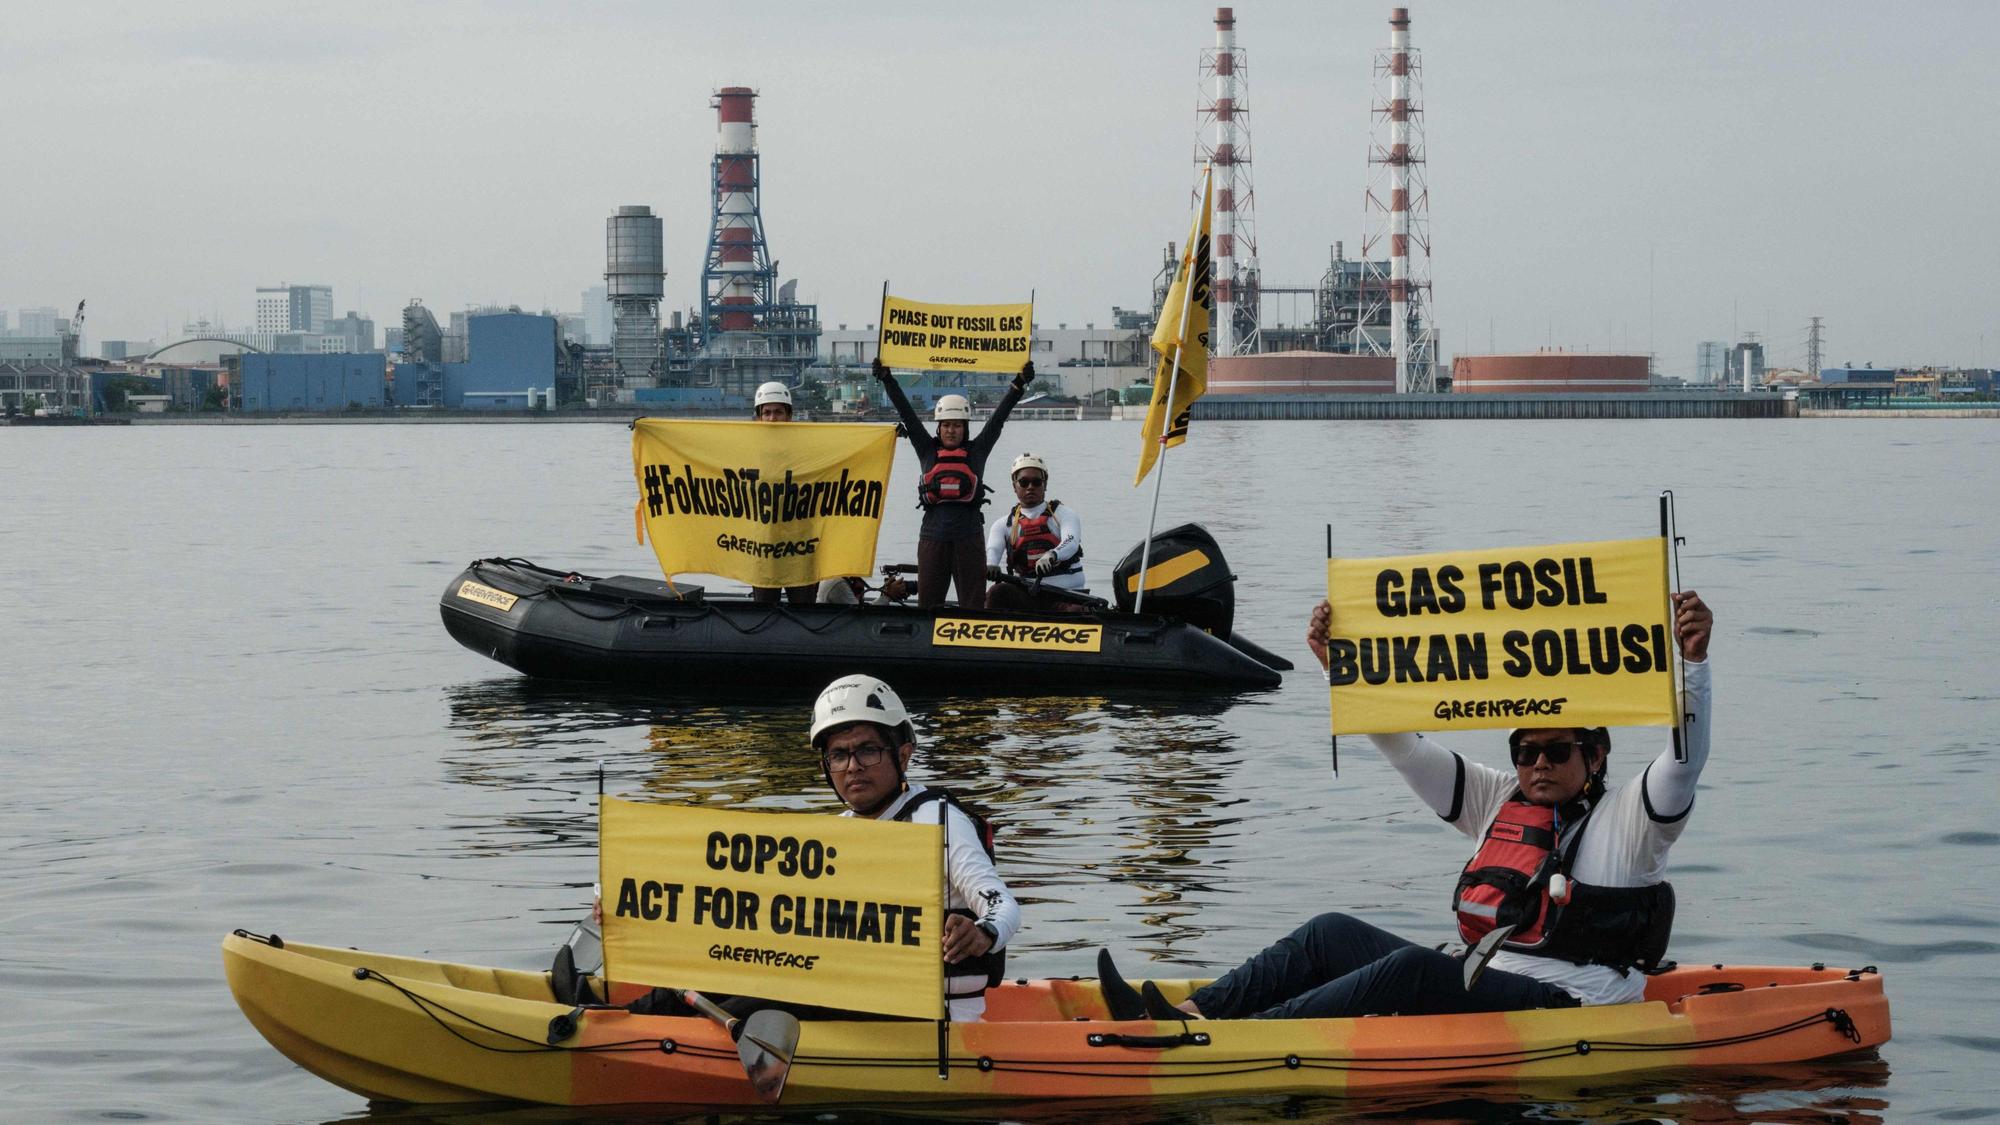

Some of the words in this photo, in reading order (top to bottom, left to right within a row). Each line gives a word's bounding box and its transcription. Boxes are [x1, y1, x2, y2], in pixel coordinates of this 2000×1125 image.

[889, 309, 928, 326] PHASE
[931, 315, 954, 328] OUT
[958, 317, 996, 332] FOSSIL
[1000, 316, 1023, 332] GAS
[884, 330, 926, 347] POWER
[930, 334, 946, 348] UP
[950, 337, 1026, 352] RENEWABLES
[929, 356, 978, 365] GREENPEACE
[644, 465, 883, 524] #FokusDiTerbarukan
[717, 534, 819, 559] GREENPEACE
[1376, 565, 1465, 617] GAS
[1478, 557, 1607, 610] FOSIL
[936, 622, 1098, 644] GREENPEACE
[1329, 632, 1488, 686] BUKAN
[1503, 624, 1667, 678] SOLUSI
[1434, 697, 1567, 720] GREENPEACE
[706, 831, 837, 878] COP30:
[616, 878, 683, 922] ACT
[694, 885, 759, 930] FOR
[770, 894, 922, 946] CLIMATE
[708, 944, 819, 970] GREENPEACE
